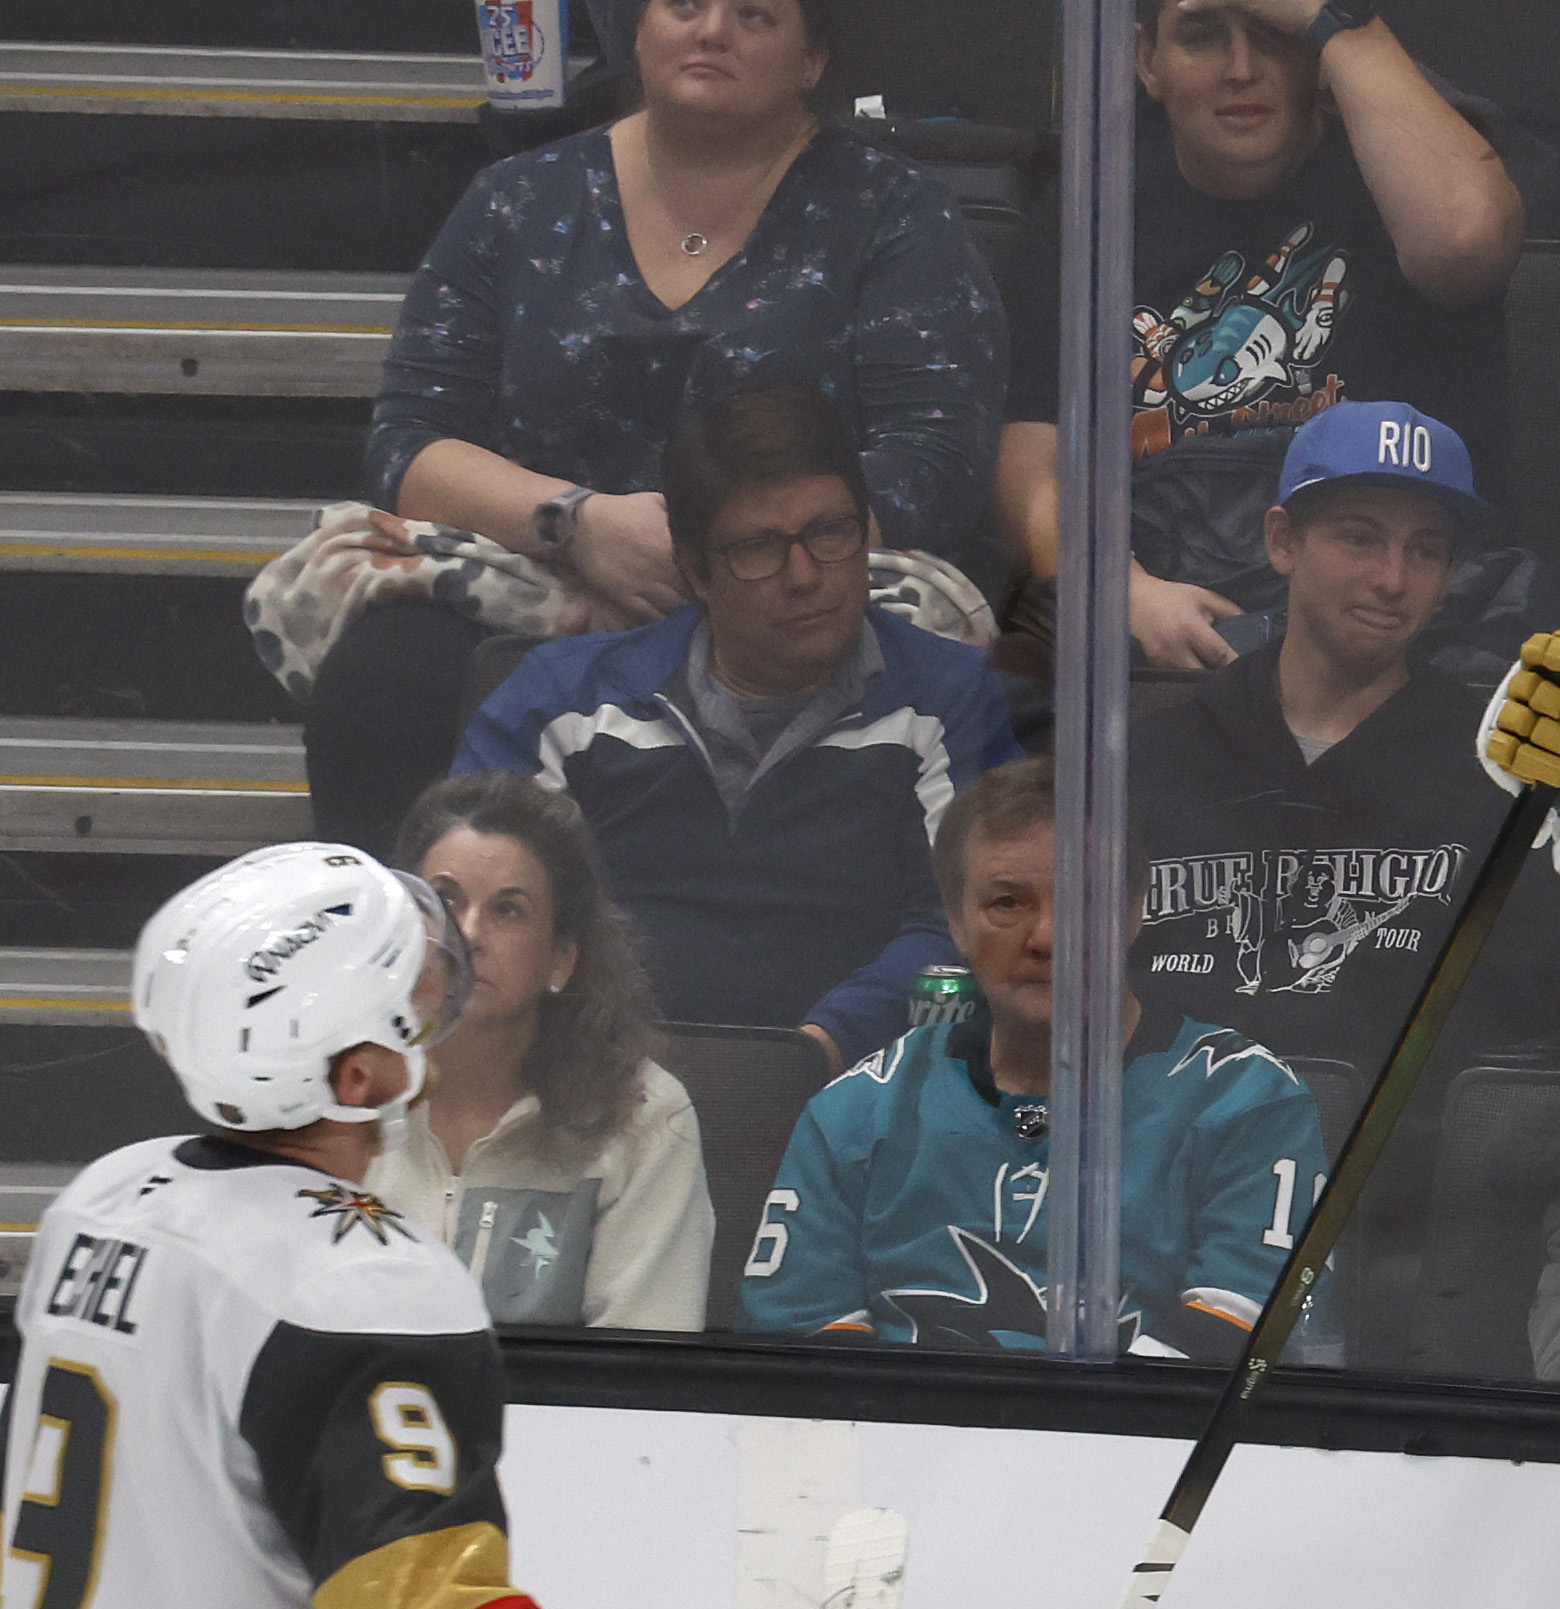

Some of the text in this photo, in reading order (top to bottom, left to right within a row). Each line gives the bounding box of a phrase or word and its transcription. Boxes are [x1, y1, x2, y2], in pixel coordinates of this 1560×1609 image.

[1378, 420, 1433, 472] RIO
[1374, 927, 1422, 952] TOUR
[1151, 953, 1215, 974] WORLD
[368, 1379, 457, 1495] 9
